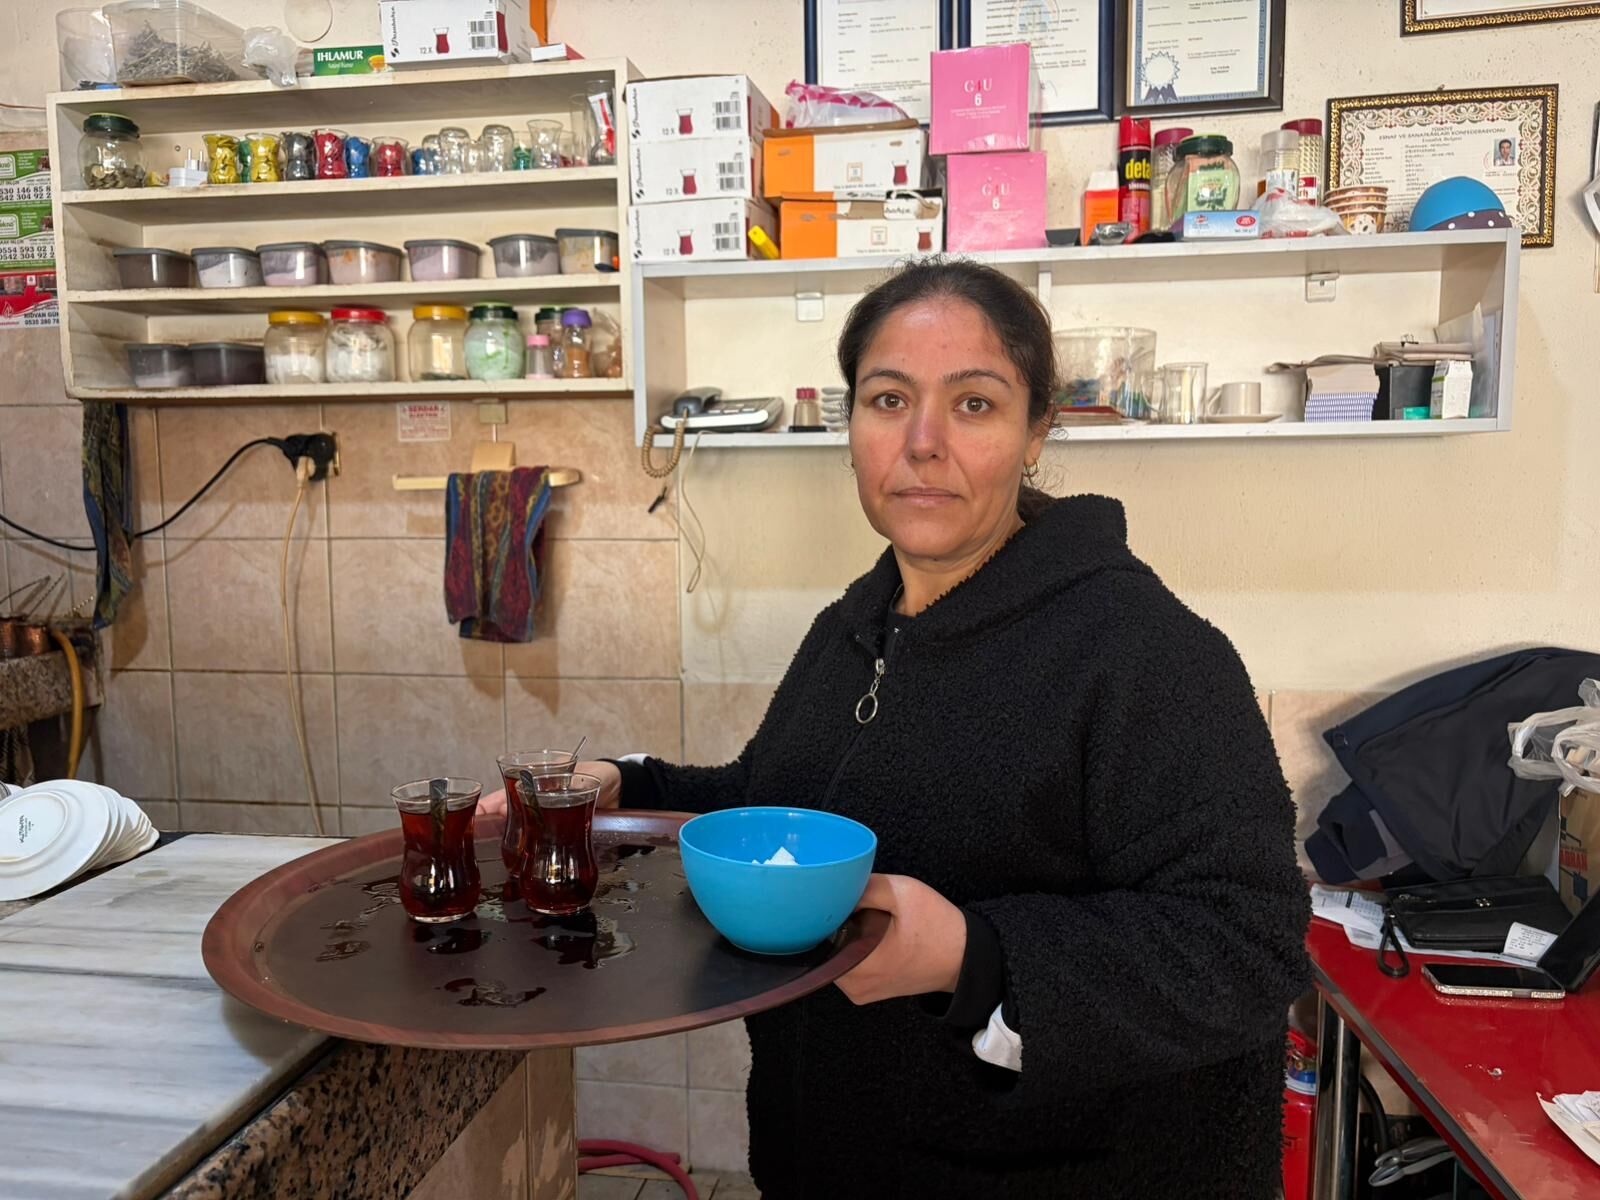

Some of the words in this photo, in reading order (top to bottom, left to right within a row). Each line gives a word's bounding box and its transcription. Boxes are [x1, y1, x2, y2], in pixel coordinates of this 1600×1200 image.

[317, 50, 364, 62] IHLAMUR
[975, 92, 982, 106] 6
[17, 186, 31, 194] 146
[992, 197, 1000, 210] 6
